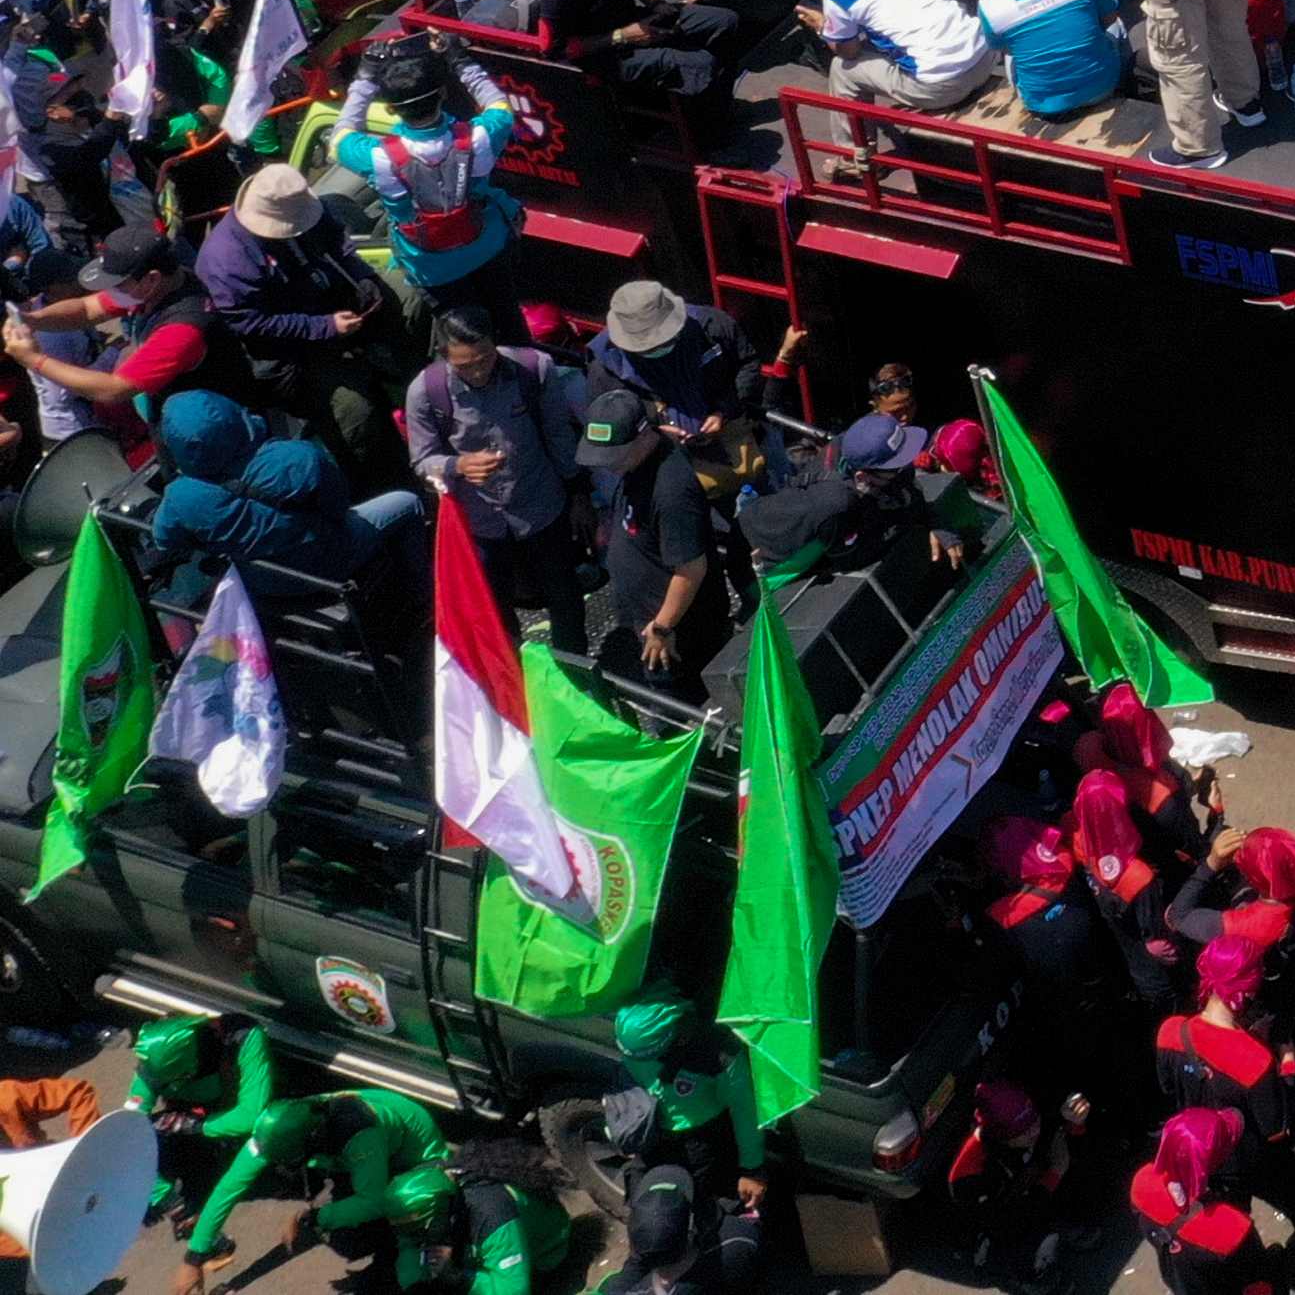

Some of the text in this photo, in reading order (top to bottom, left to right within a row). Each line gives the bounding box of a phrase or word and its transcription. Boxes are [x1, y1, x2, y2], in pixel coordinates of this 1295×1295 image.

[1175, 234, 1279, 291] FSPMI
[1131, 529, 1197, 567] FSPMI
[890, 678, 981, 797] MENOLAK
[973, 576, 1047, 686] OMNIBU
